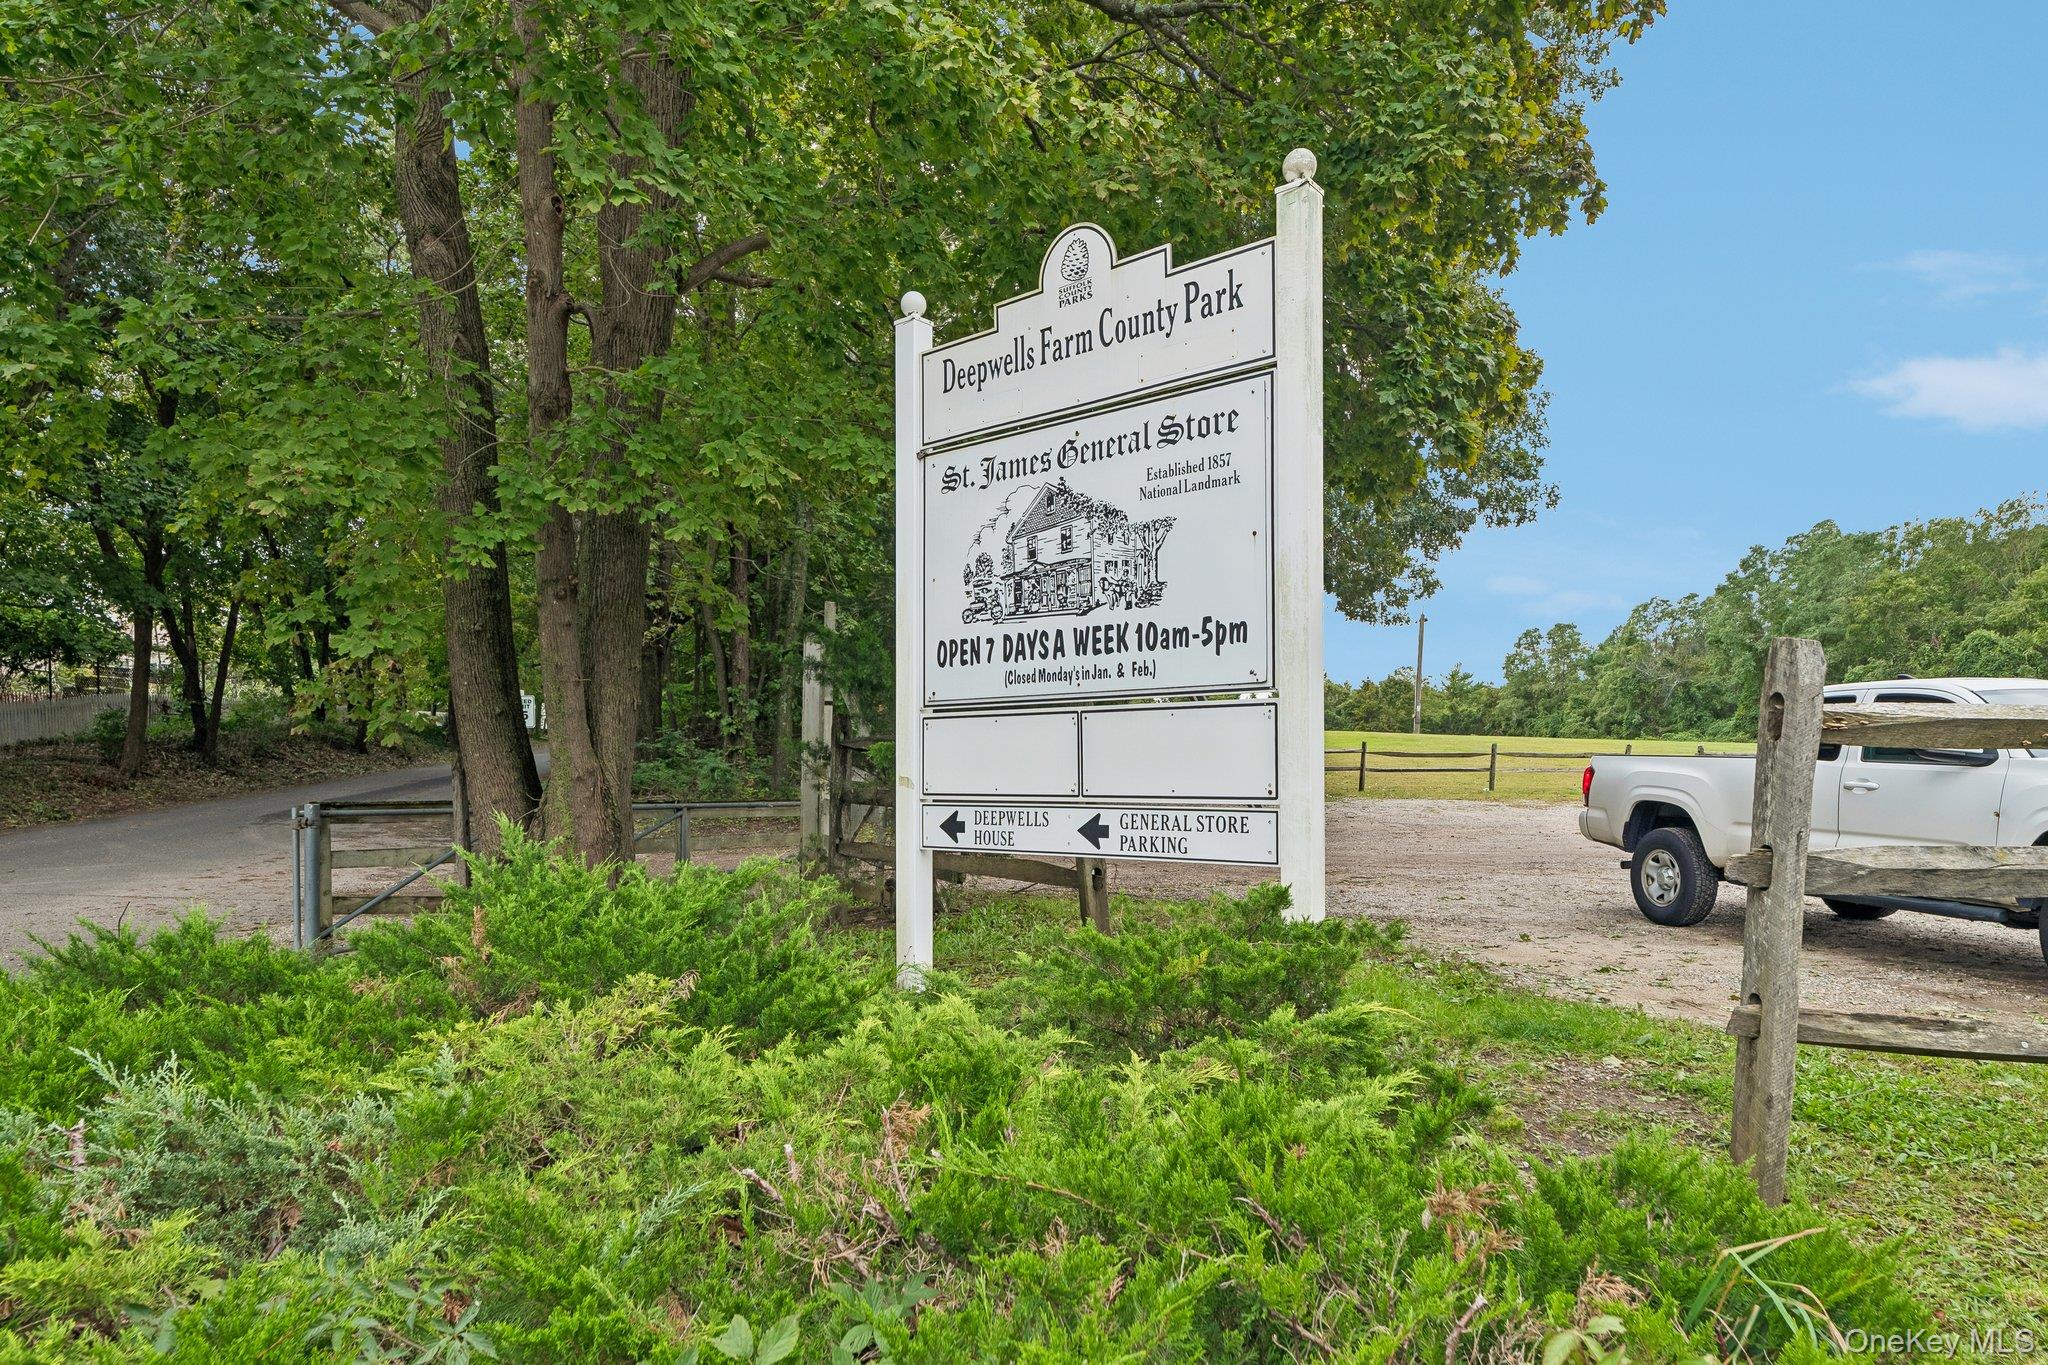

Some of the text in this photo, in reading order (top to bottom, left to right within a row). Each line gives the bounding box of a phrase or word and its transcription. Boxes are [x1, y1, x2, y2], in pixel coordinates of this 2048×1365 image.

[1059, 279, 1092, 294] SUFFOLK
[1059, 286, 1092, 300] COUNTY
[1059, 291, 1093, 308] PARKS
[942, 269, 1244, 393] Deepwells Farm County Park
[941, 408, 1239, 494] St. James General Store
[1146, 452, 1232, 482] Established 1857
[1139, 471, 1241, 501] National Landmark
[937, 616, 1248, 668] OPEN 7 DAYS A WEEK 10am-5pm
[1004, 659, 1156, 688] (Closed Monday's in Jan. & Feb.)
[974, 810, 1049, 828] DEEPWELLS
[1119, 813, 1250, 834] GENERAL STORE
[974, 830, 1015, 847] HOUSE
[1119, 835, 1188, 855] PARKING
